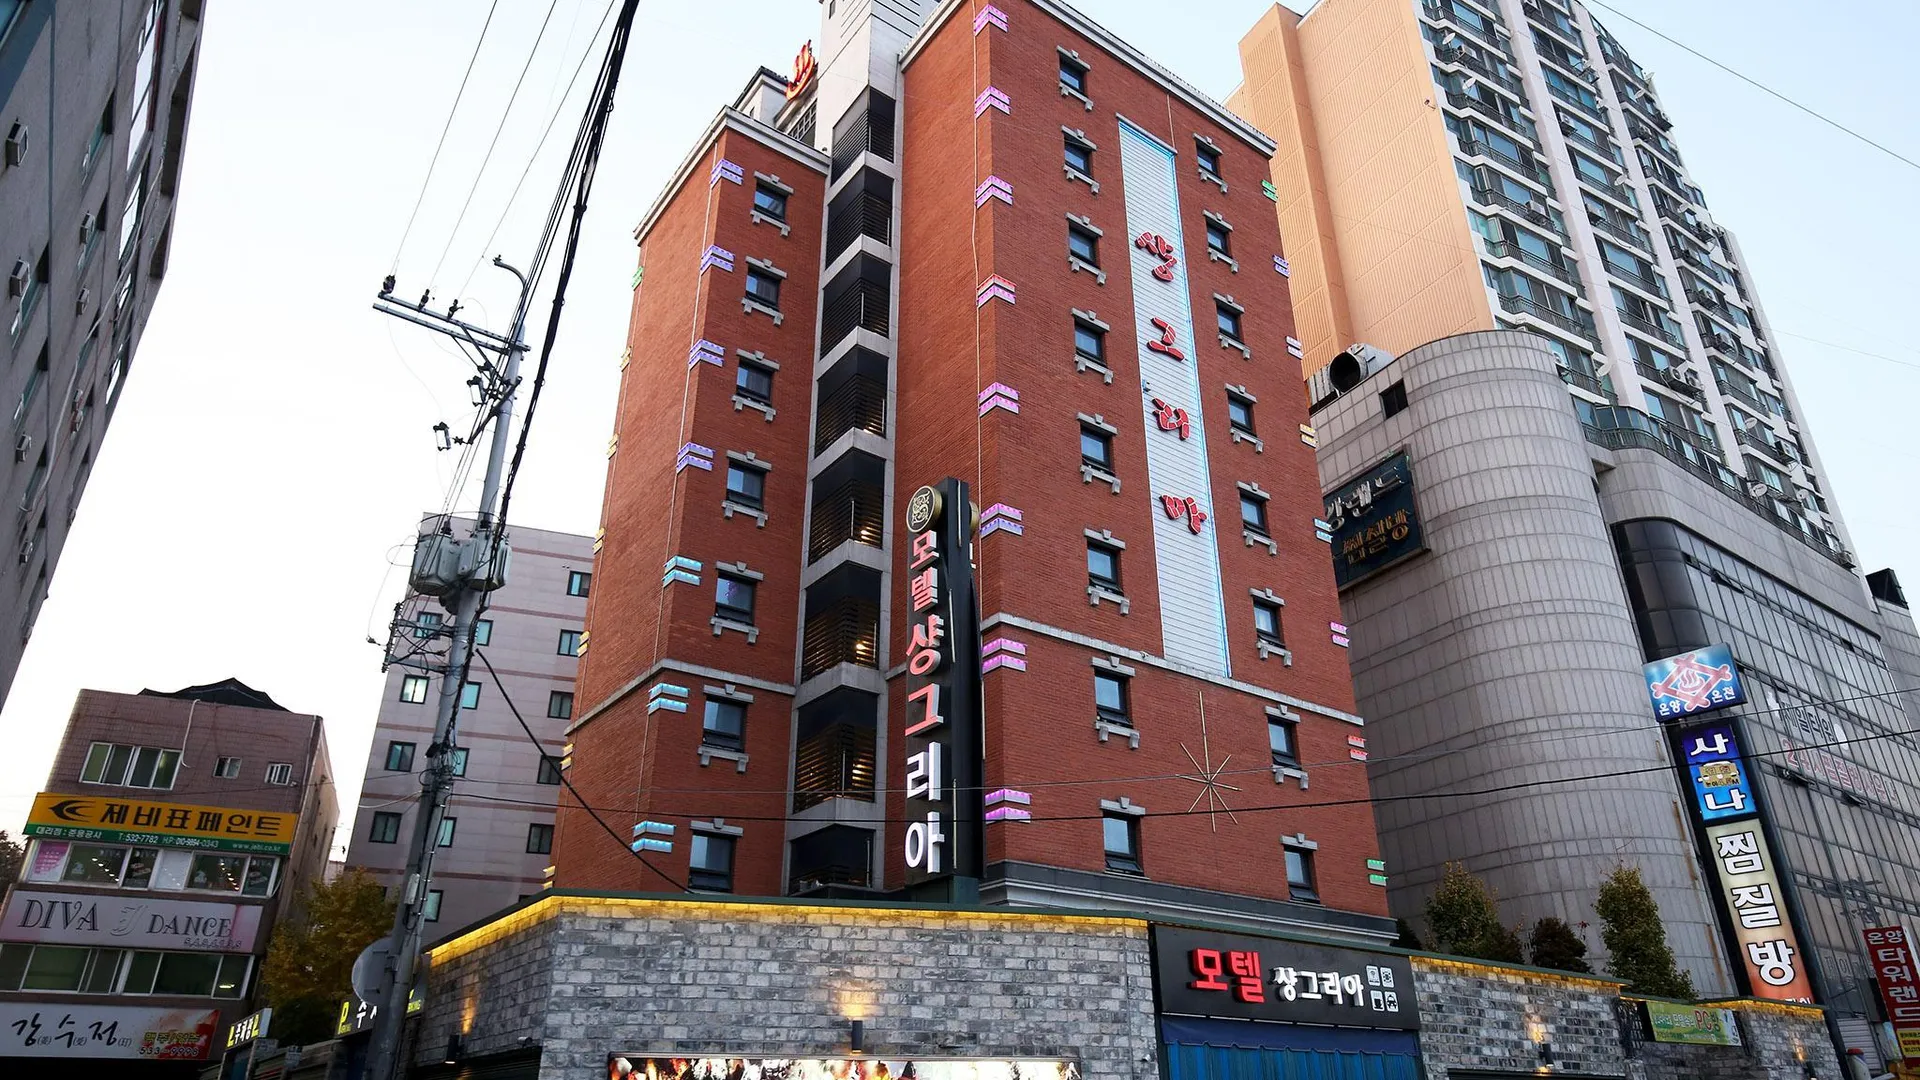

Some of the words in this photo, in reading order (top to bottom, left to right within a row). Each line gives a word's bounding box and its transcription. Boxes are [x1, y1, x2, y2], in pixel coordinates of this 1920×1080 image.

[909, 529, 939, 613] 모텔
[1659, 700, 1681, 716] 온양
[1712, 685, 1736, 703] 온천
[905, 614, 946, 874] 샹그리아
[99, 803, 282, 837] 제비표페인트
[18, 899, 100, 932] DIVA
[146, 914, 234, 938] DANCE
[1715, 831, 1796, 987] 찜질방
[1867, 929, 1903, 945] 온양
[1190, 948, 1265, 1004] 모텔
